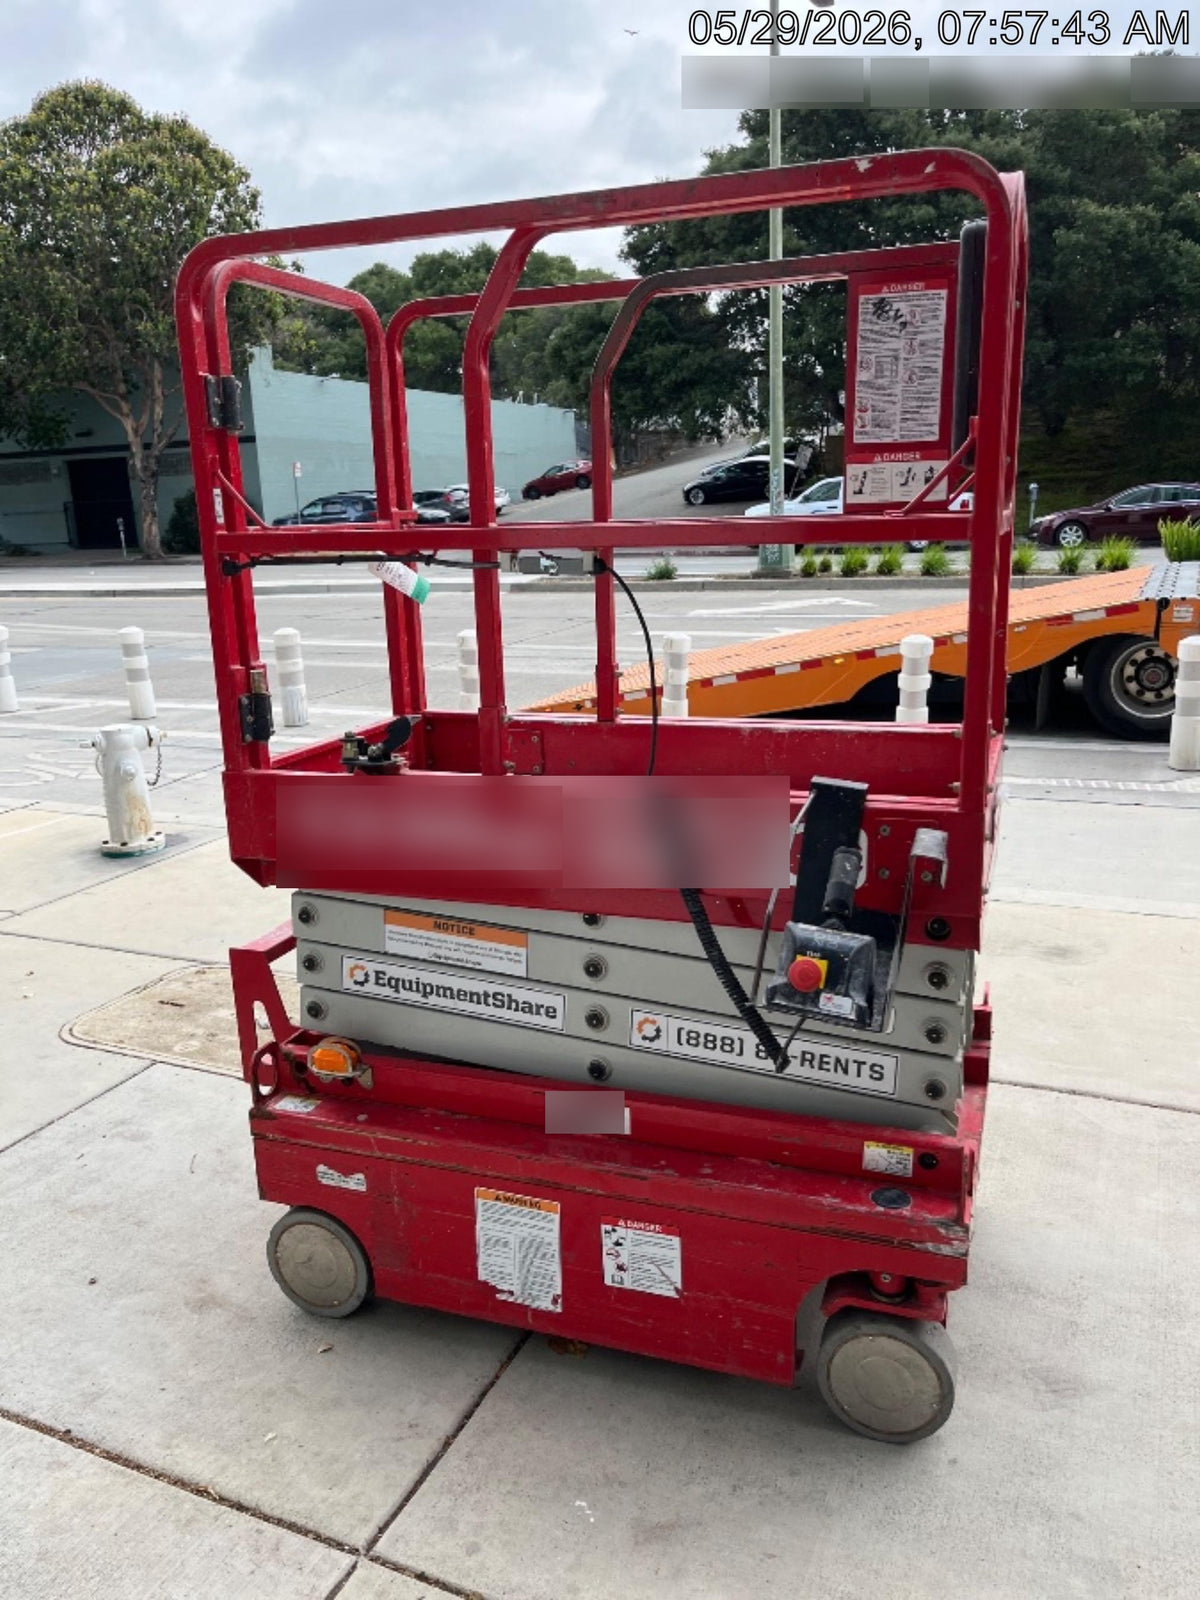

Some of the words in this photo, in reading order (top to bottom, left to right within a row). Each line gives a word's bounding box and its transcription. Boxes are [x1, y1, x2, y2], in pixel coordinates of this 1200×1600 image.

[883, 452, 921, 461] DANGER
[433, 920, 476, 936] NOTICE
[373, 970, 557, 1019] EquipmentShare
[675, 1026, 744, 1057] (888)
[755, 1041, 884, 1081] 8-RENTS
[627, 1221, 663, 1233] DANGER
